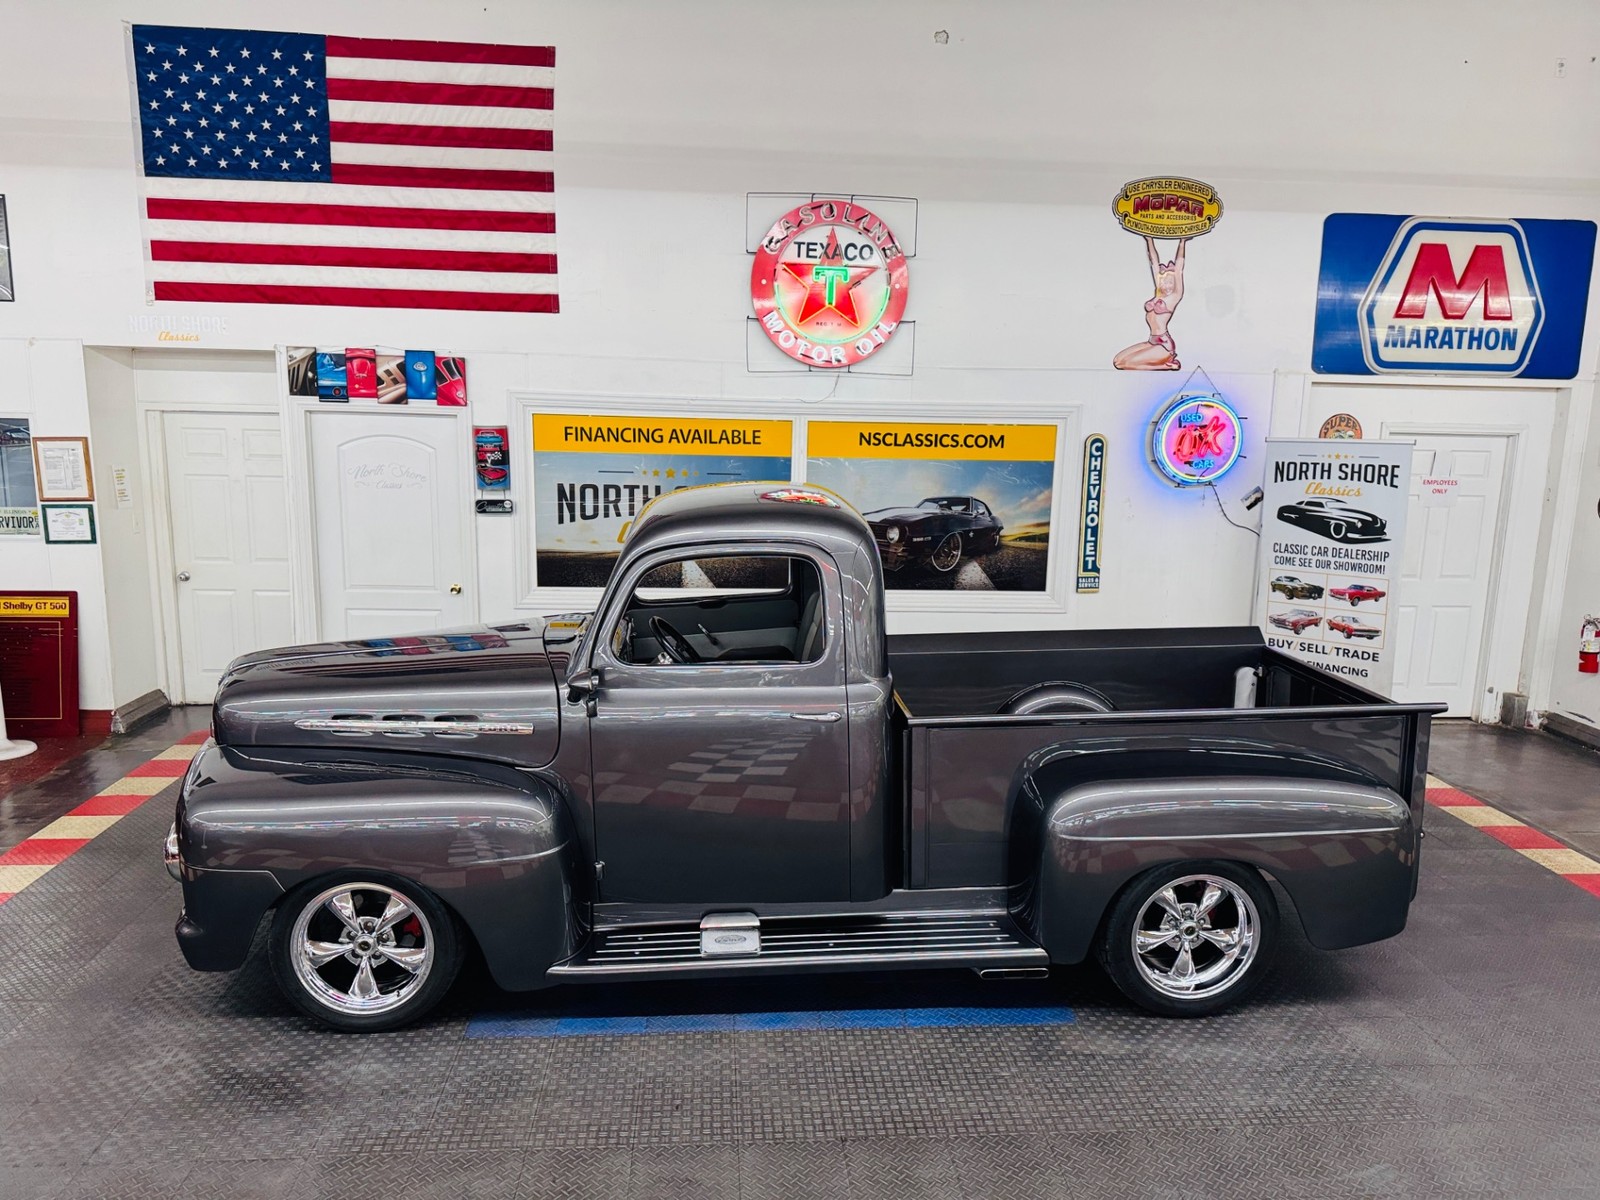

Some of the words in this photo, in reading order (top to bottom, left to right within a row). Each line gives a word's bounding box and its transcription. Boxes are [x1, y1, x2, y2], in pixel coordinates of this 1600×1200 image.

[1128, 184, 1140, 193] USE
[1142, 180, 1172, 190] CHRYSLER
[1173, 180, 1210, 197] ENGINEERED
[765, 202, 901, 262] GASOLINE
[794, 241, 874, 261] TEXACO
[158, 331, 201, 341] Classics
[763, 310, 847, 364] MOTOR
[856, 321, 898, 355] OIL
[1383, 325, 1518, 350] MARATHON
[1180, 414, 1203, 422] USED
[1324, 415, 1358, 434] SUPER
[564, 426, 664, 444] FINANCING
[668, 429, 761, 445] AVAILABLE
[859, 432, 1005, 449] NSCLASSICS.COM
[1274, 461, 1331, 484] NORTH
[1338, 463, 1400, 489] SHORE
[1304, 482, 1363, 497] Classics
[1085, 442, 1103, 569] CHEVROLET
[1273, 543, 1309, 556] CLASSIC
[1311, 545, 1329, 557] CAR
[1331, 547, 1390, 562] DEALERSHIP
[1274, 556, 1296, 566] COME
[1298, 557, 1312, 568] SEE
[1315, 559, 1331, 569] OUR
[1333, 561, 1386, 575] SHOWROOM!
[3, 601, 33, 611] Shelby
[35, 602, 48, 610] GT
[49, 602, 67, 610] 500
